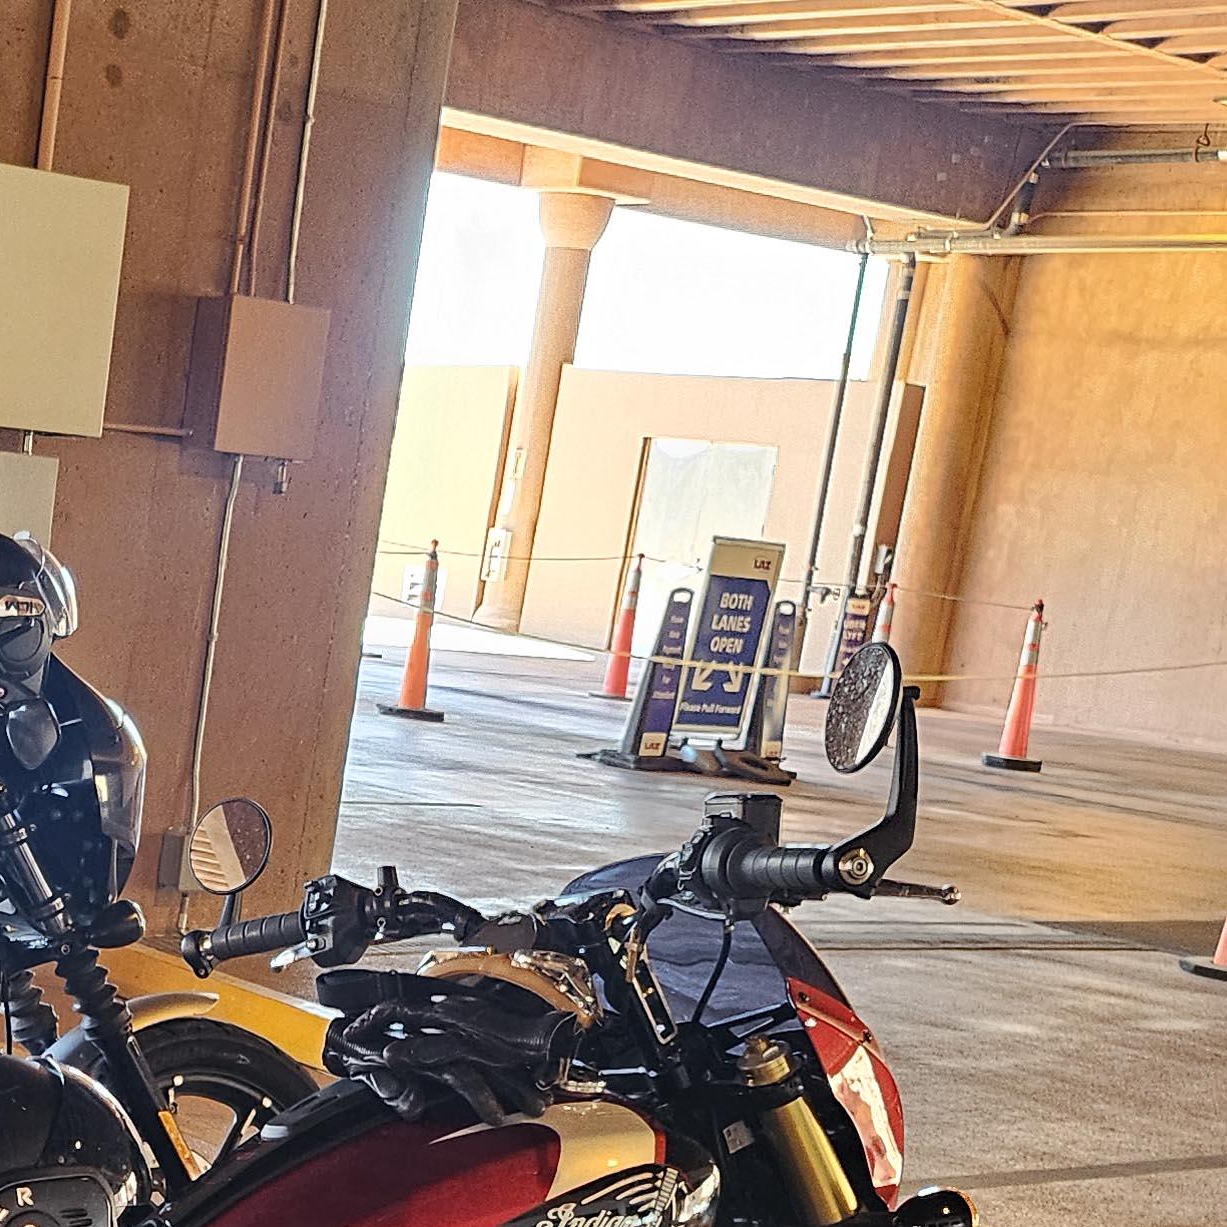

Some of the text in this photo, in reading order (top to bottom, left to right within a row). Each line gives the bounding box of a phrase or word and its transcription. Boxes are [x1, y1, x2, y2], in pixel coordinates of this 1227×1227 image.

[719, 592, 754, 610] BOTH
[711, 614, 751, 633] LANES
[709, 636, 744, 654] OPEN
